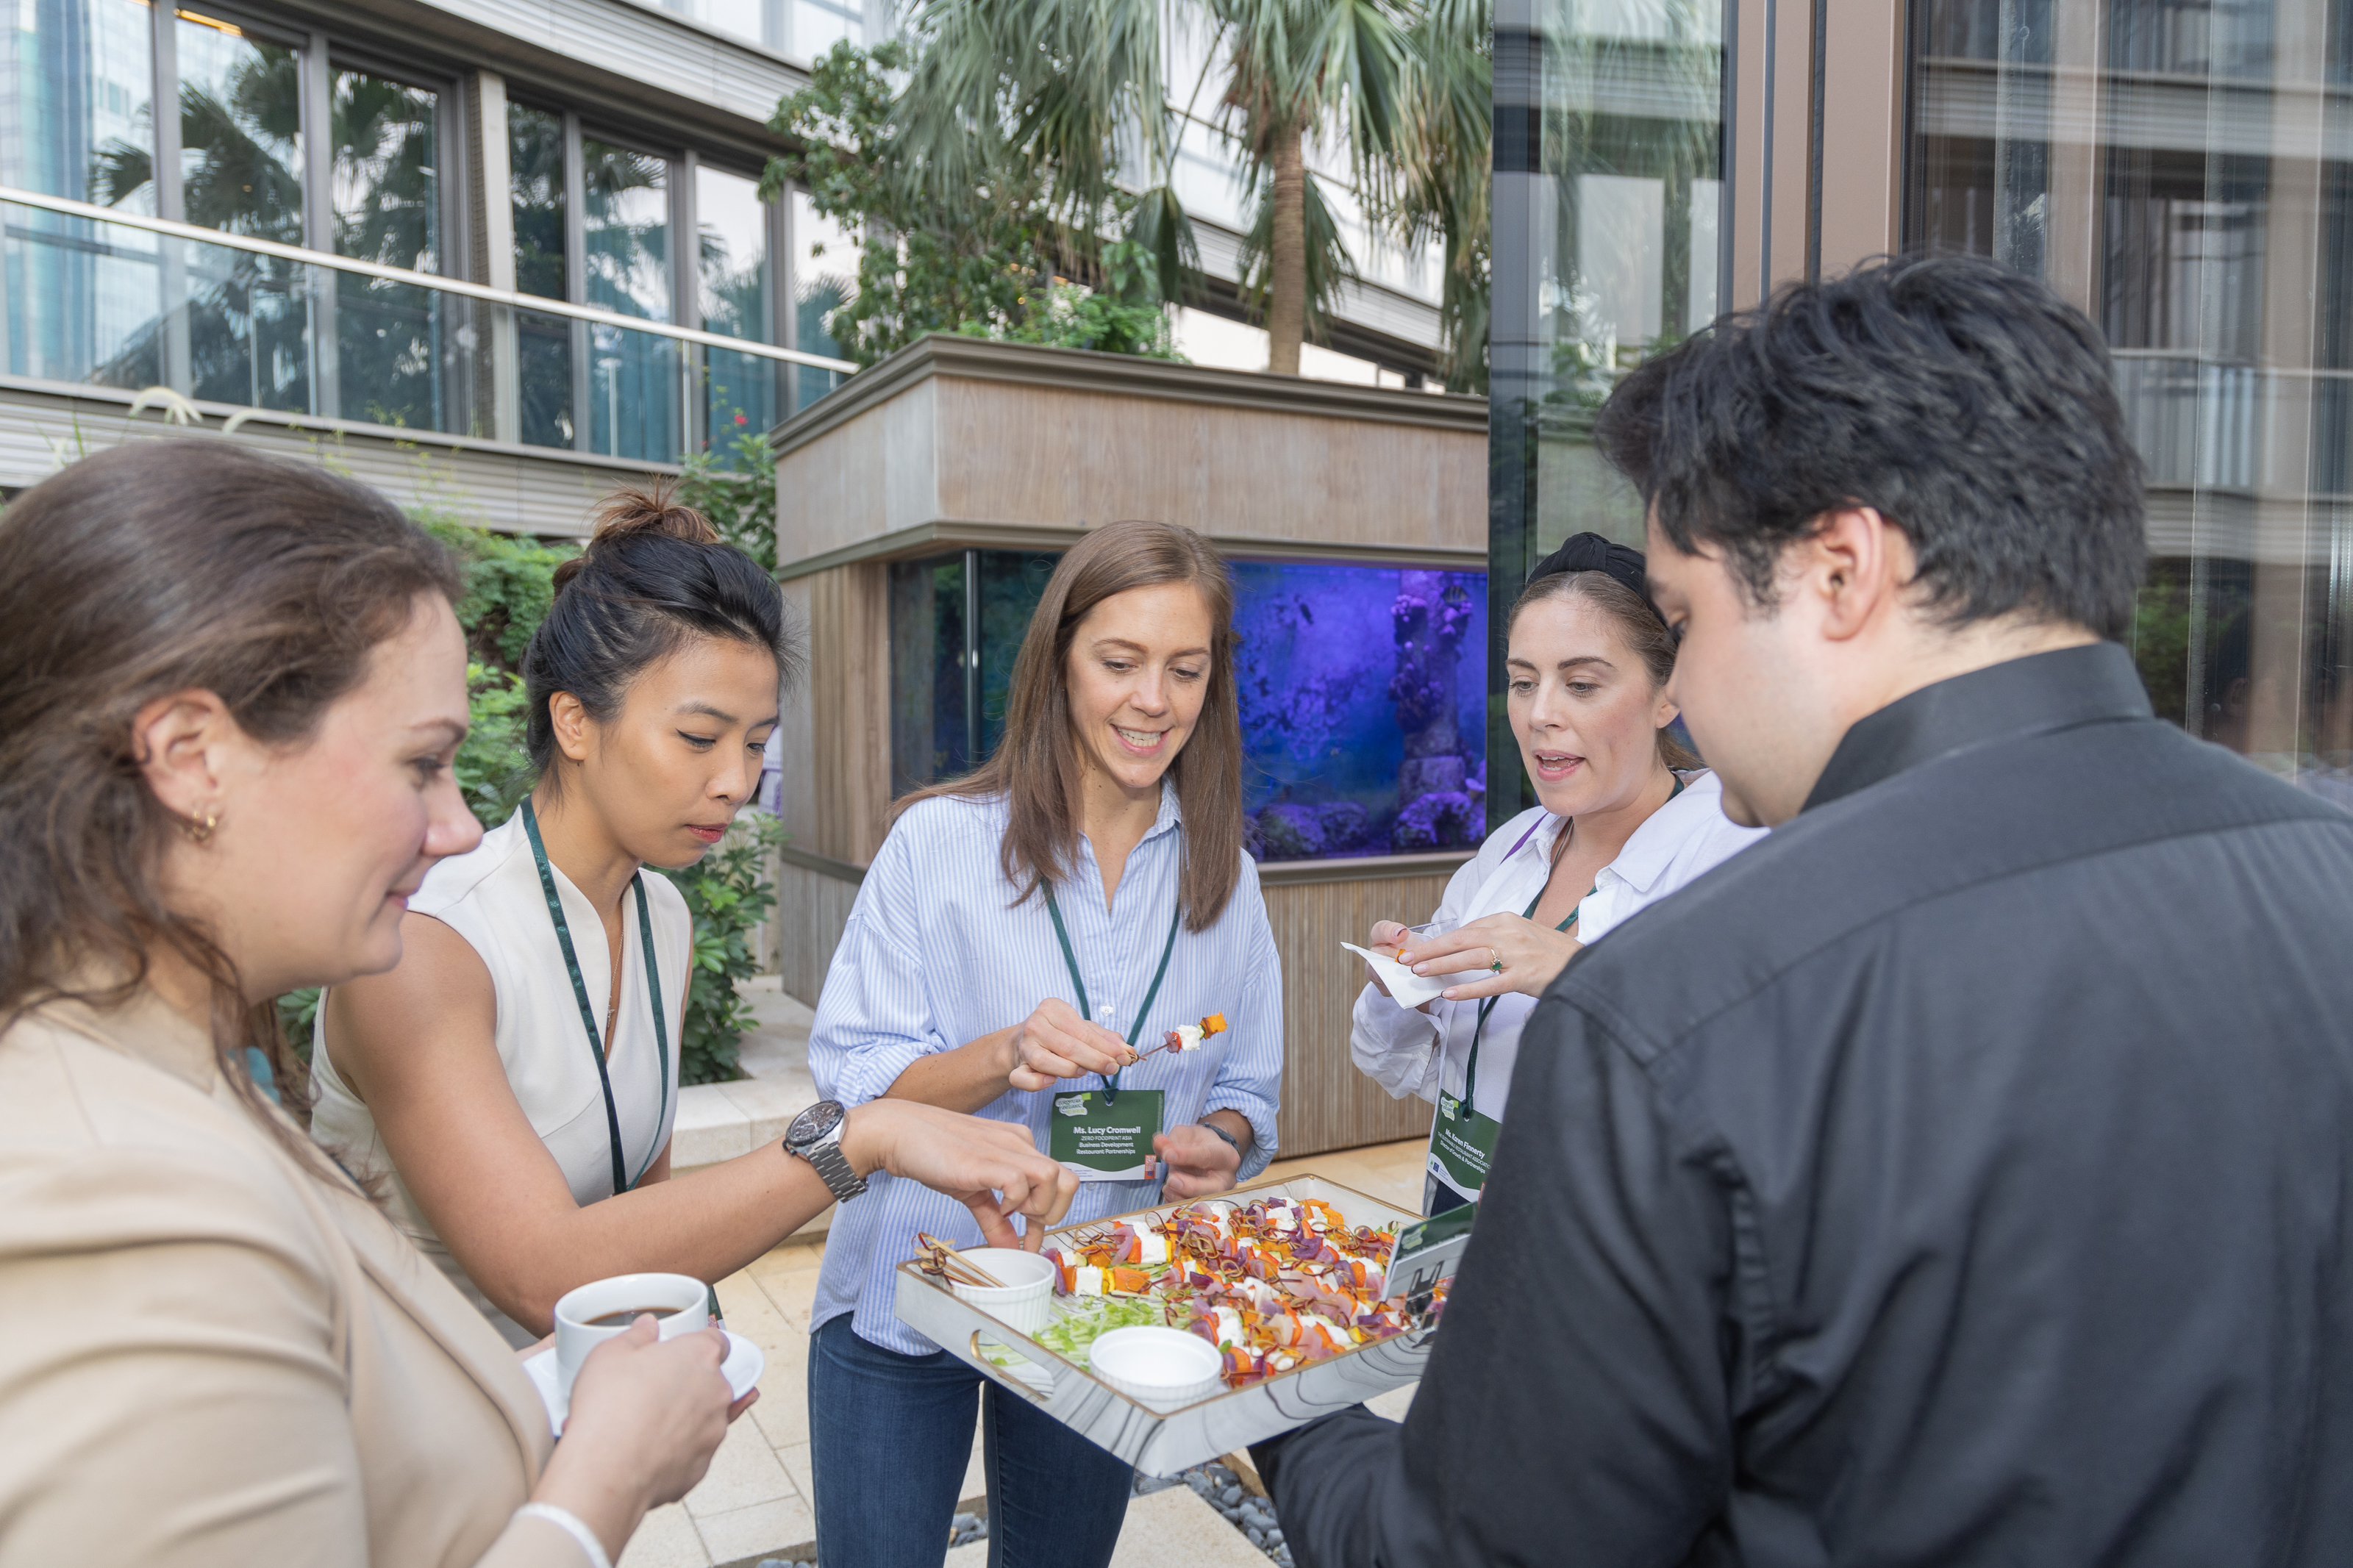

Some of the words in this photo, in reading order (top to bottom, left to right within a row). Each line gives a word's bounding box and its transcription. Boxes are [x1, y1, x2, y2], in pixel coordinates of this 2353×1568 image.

[1088, 1126, 1105, 1136] Lucy
[1440, 1139, 1449, 1150] Director
[1452, 1149, 1462, 1160] Growth
[1465, 1158, 1485, 1174] Partnerships
[1452, 1133, 1464, 1147] Karen
[1463, 1141, 1485, 1159] Finnerty
[1455, 1145, 1473, 1159] RESTAURANT
[1472, 1156, 1491, 1170] ASSOCIATIO
